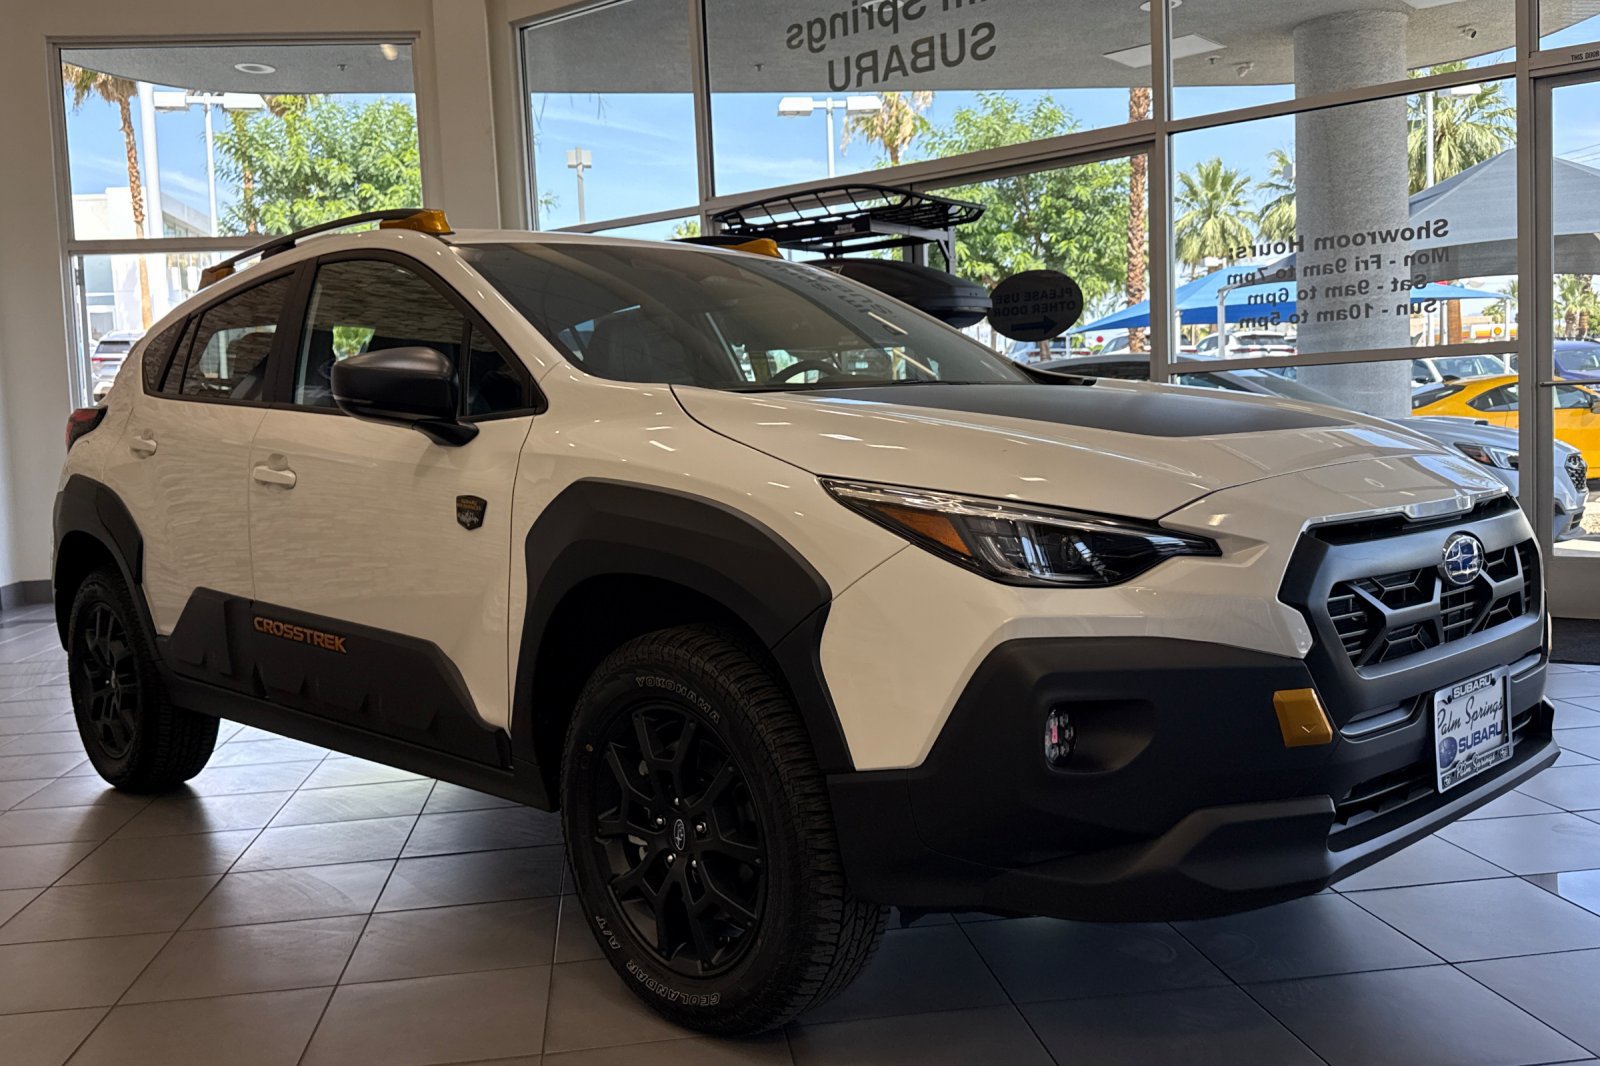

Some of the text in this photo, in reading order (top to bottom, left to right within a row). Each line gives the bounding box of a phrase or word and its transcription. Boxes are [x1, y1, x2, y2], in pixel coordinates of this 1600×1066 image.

[1571, 53, 1584, 62] THIS
[253, 616, 347, 654] CROSSTREK
[635, 676, 720, 724] YOKOHAMA
[1453, 676, 1492, 699] SUBARU
[1438, 695, 1503, 736] Palm Springs
[1458, 720, 1503, 754] SUBARU
[595, 915, 720, 1006] GEOLANDAR A/T
